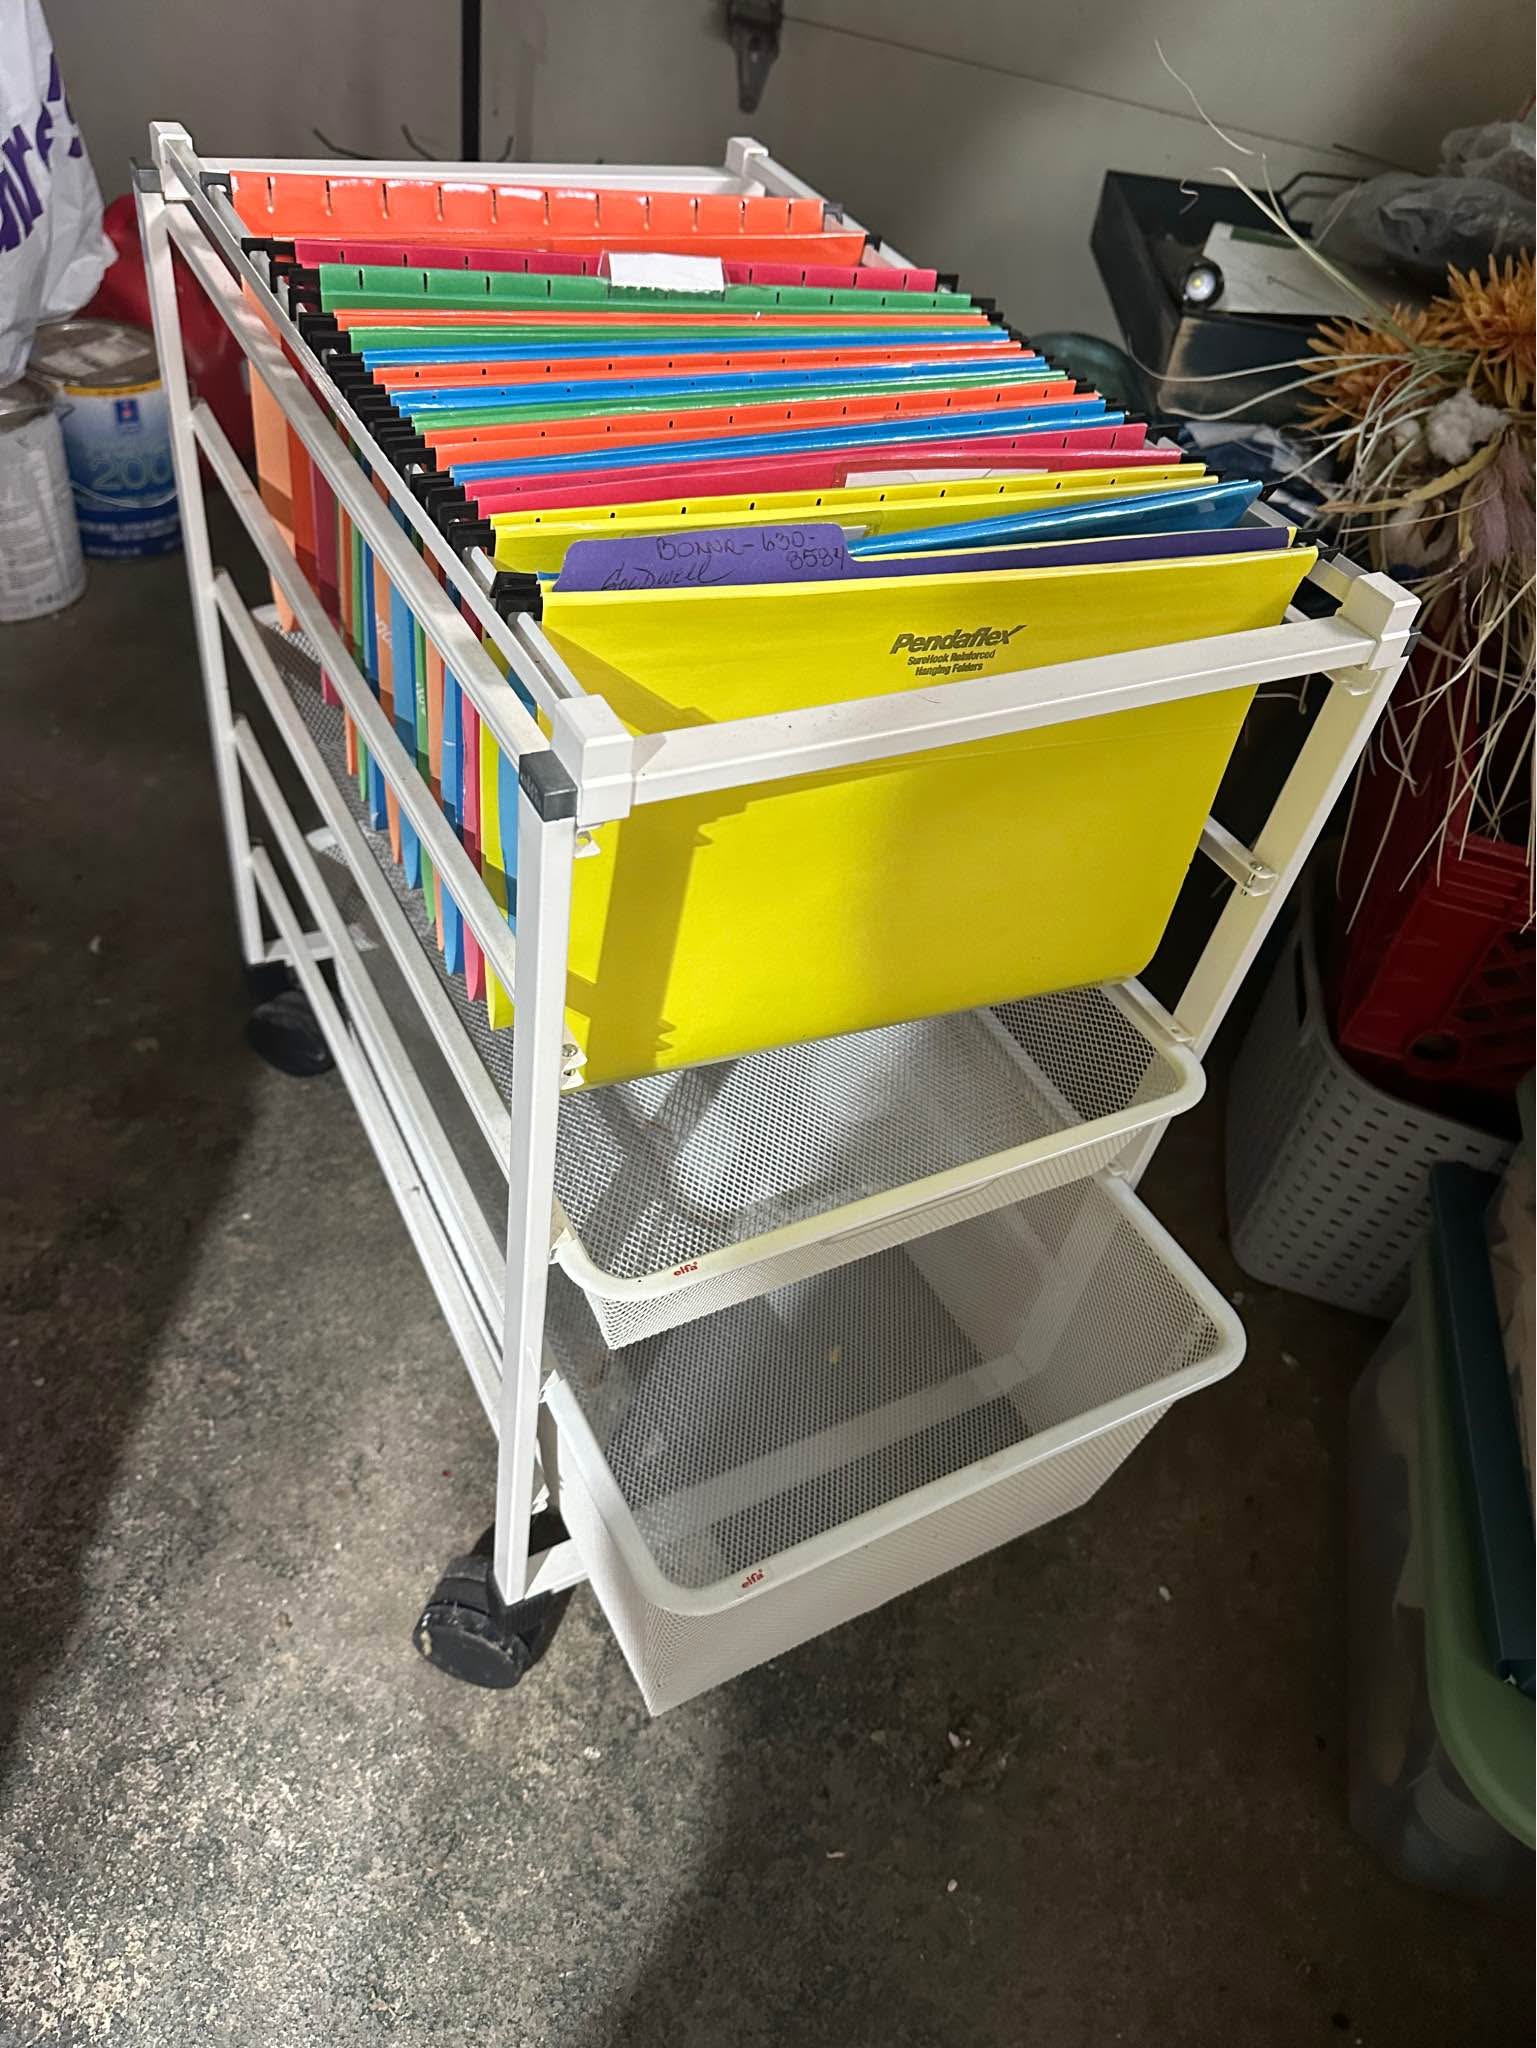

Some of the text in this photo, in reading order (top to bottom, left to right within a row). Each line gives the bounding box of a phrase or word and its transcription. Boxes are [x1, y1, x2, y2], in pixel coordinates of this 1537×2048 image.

[91, 451, 172, 491] 200
[889, 624, 1027, 654] Pendaflex
[907, 650, 996, 666] SureHook Reinforced
[915, 662, 983, 677] Hanging Folders
[673, 1262, 698, 1277] elfa
[742, 1571, 764, 1589] elfa
